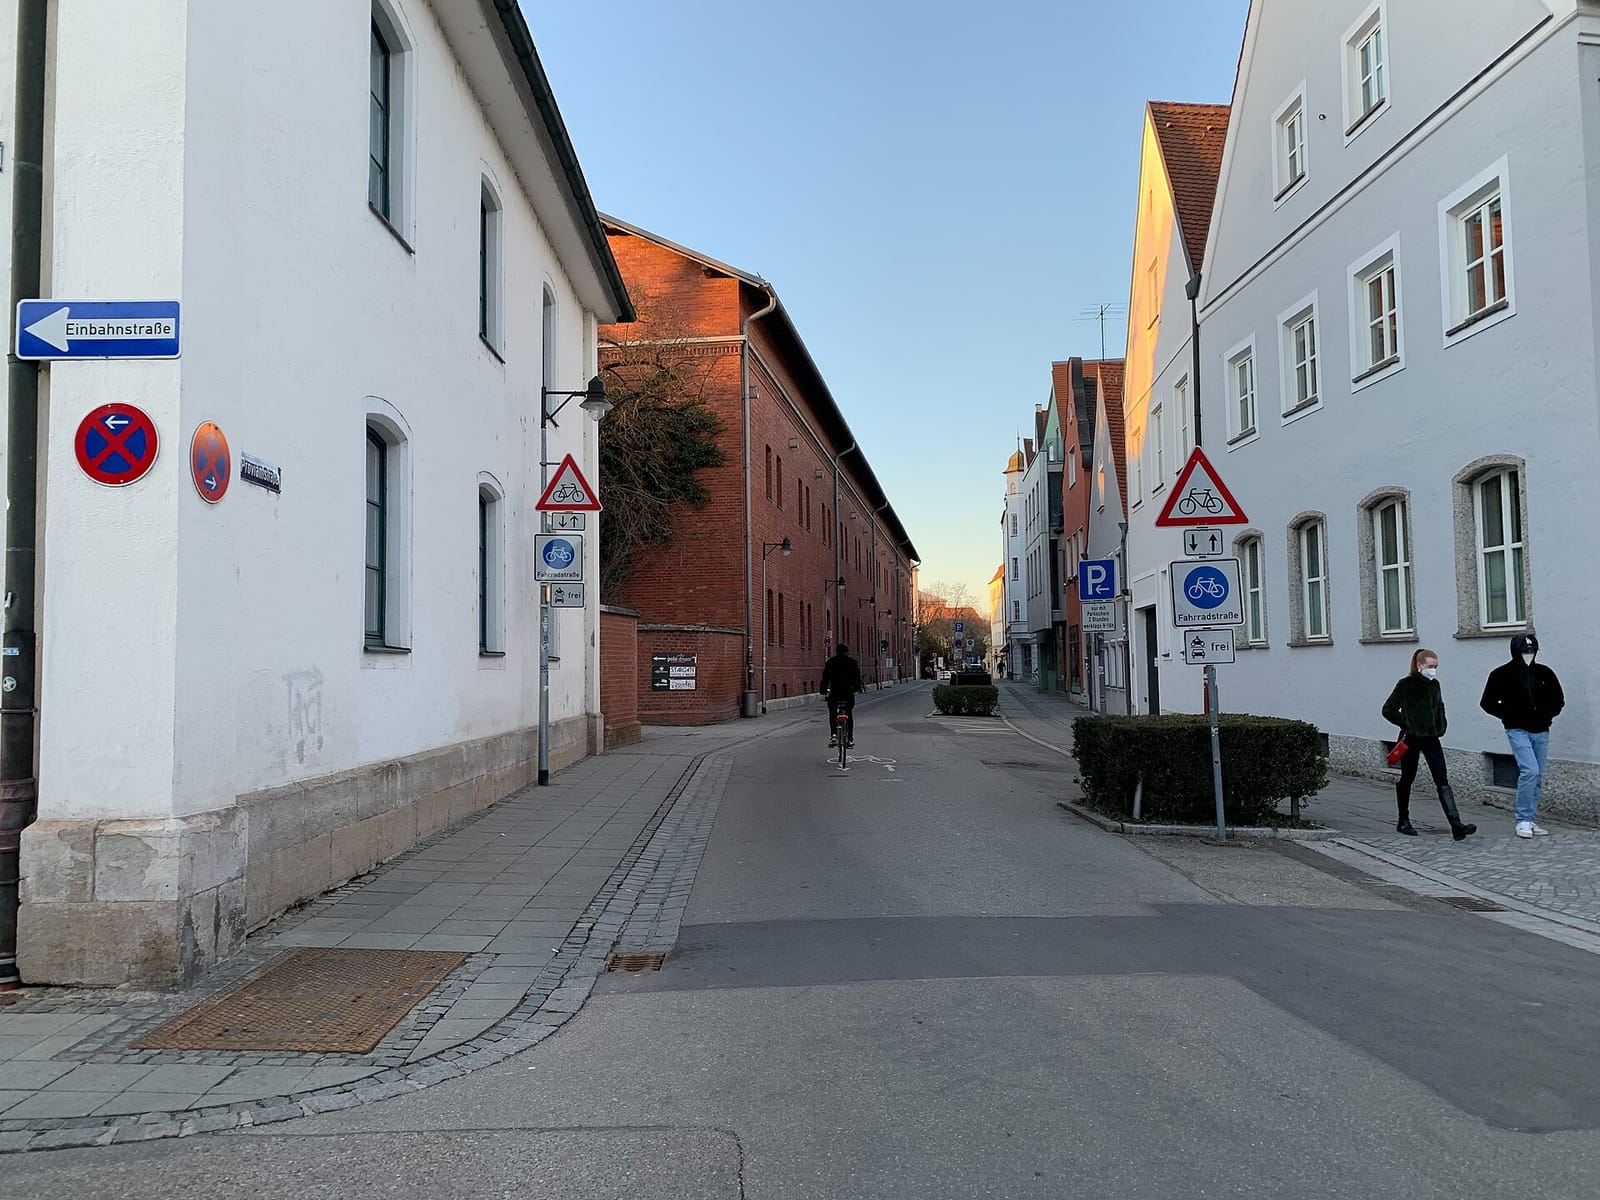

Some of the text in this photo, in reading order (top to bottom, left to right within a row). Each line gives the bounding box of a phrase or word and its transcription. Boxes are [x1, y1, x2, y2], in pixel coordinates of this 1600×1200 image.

[66, 322, 171, 336] Einbahnstraße
[1087, 565, 1107, 595] P
[568, 592, 581, 600] frei
[1178, 611, 1239, 622] Fahrradstraße
[1211, 641, 1229, 652] frei
